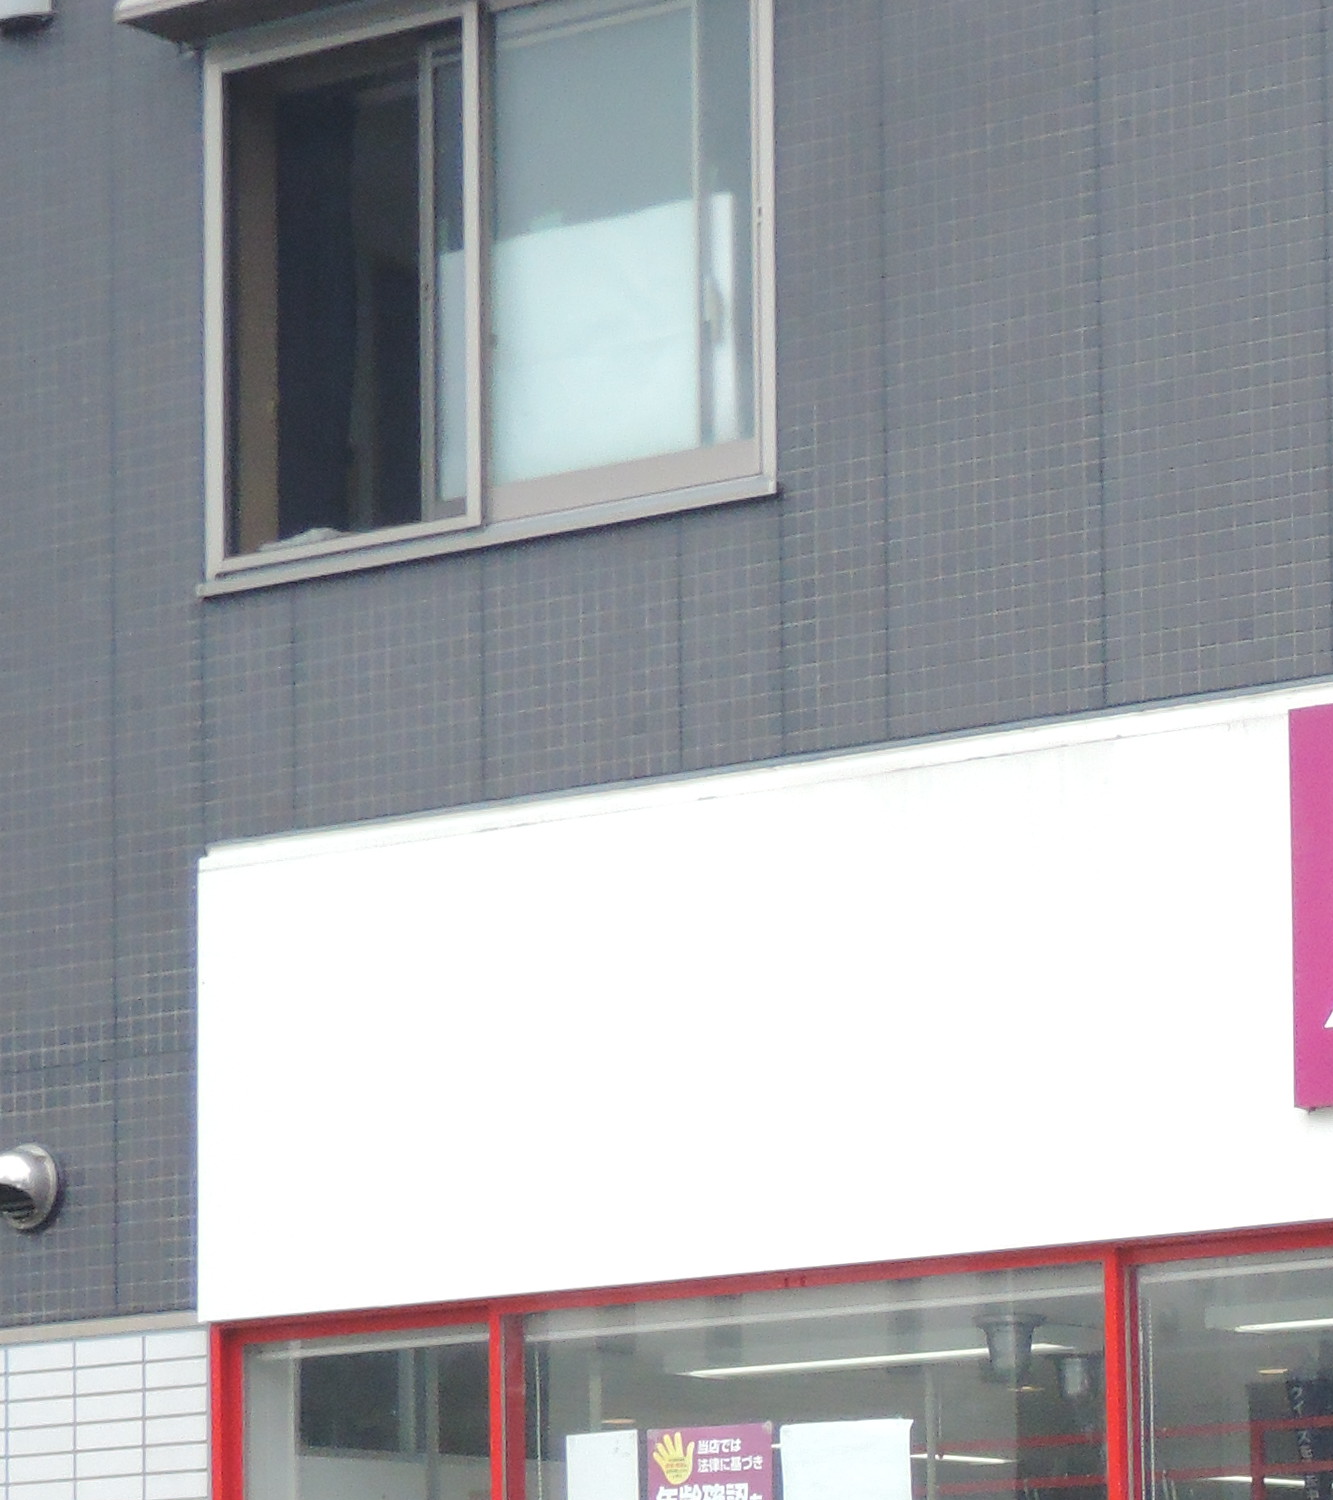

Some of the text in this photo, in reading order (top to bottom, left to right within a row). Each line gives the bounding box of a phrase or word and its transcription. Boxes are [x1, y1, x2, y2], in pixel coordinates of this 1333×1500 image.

[697, 1438, 742, 1454] 当店では
[697, 1455, 764, 1473] 法律に基づき
